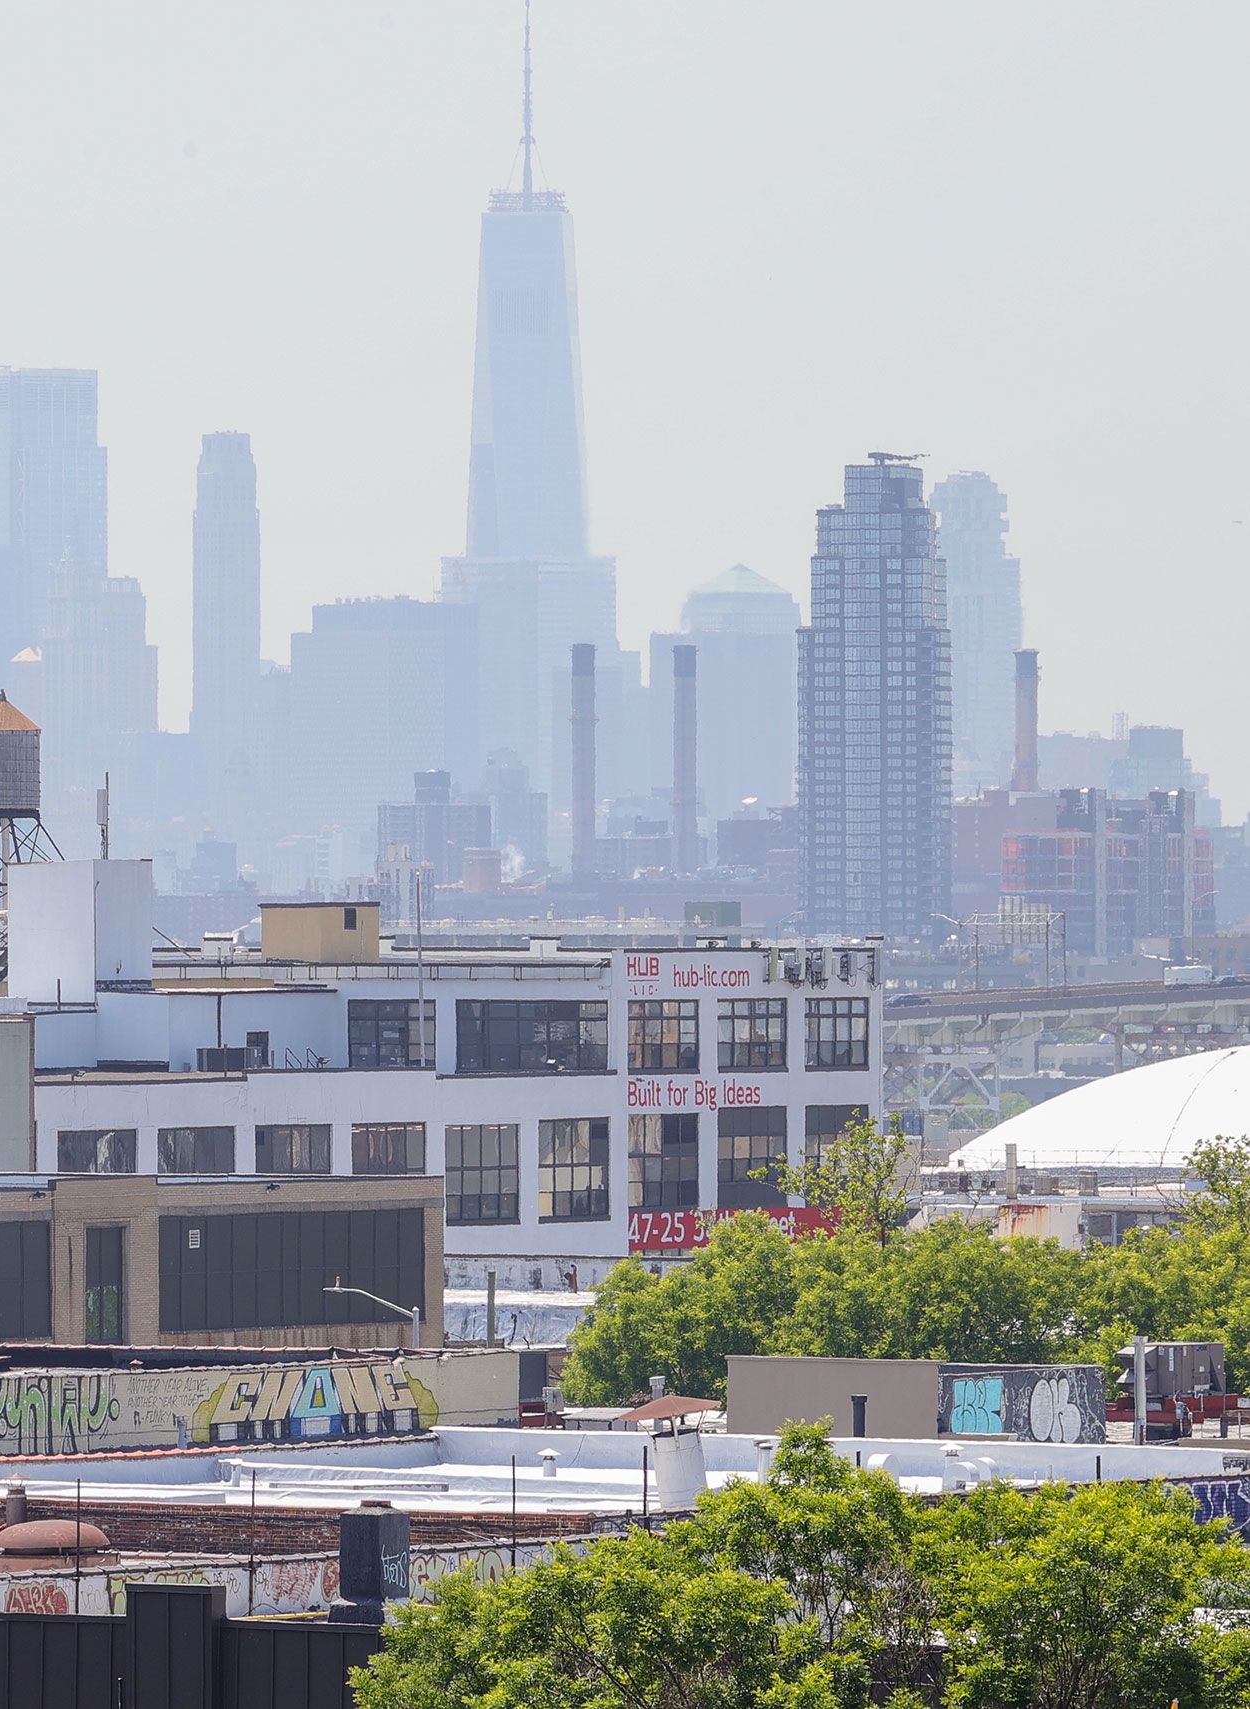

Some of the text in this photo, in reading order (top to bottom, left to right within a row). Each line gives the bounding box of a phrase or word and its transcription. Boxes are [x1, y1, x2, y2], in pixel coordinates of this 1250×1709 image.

[627, 957, 659, 976] HUB
[673, 964, 750, 988] hub-lic.com
[627, 1079, 761, 1111] Built for Big Ideas
[628, 1212, 685, 1243] 47-25
